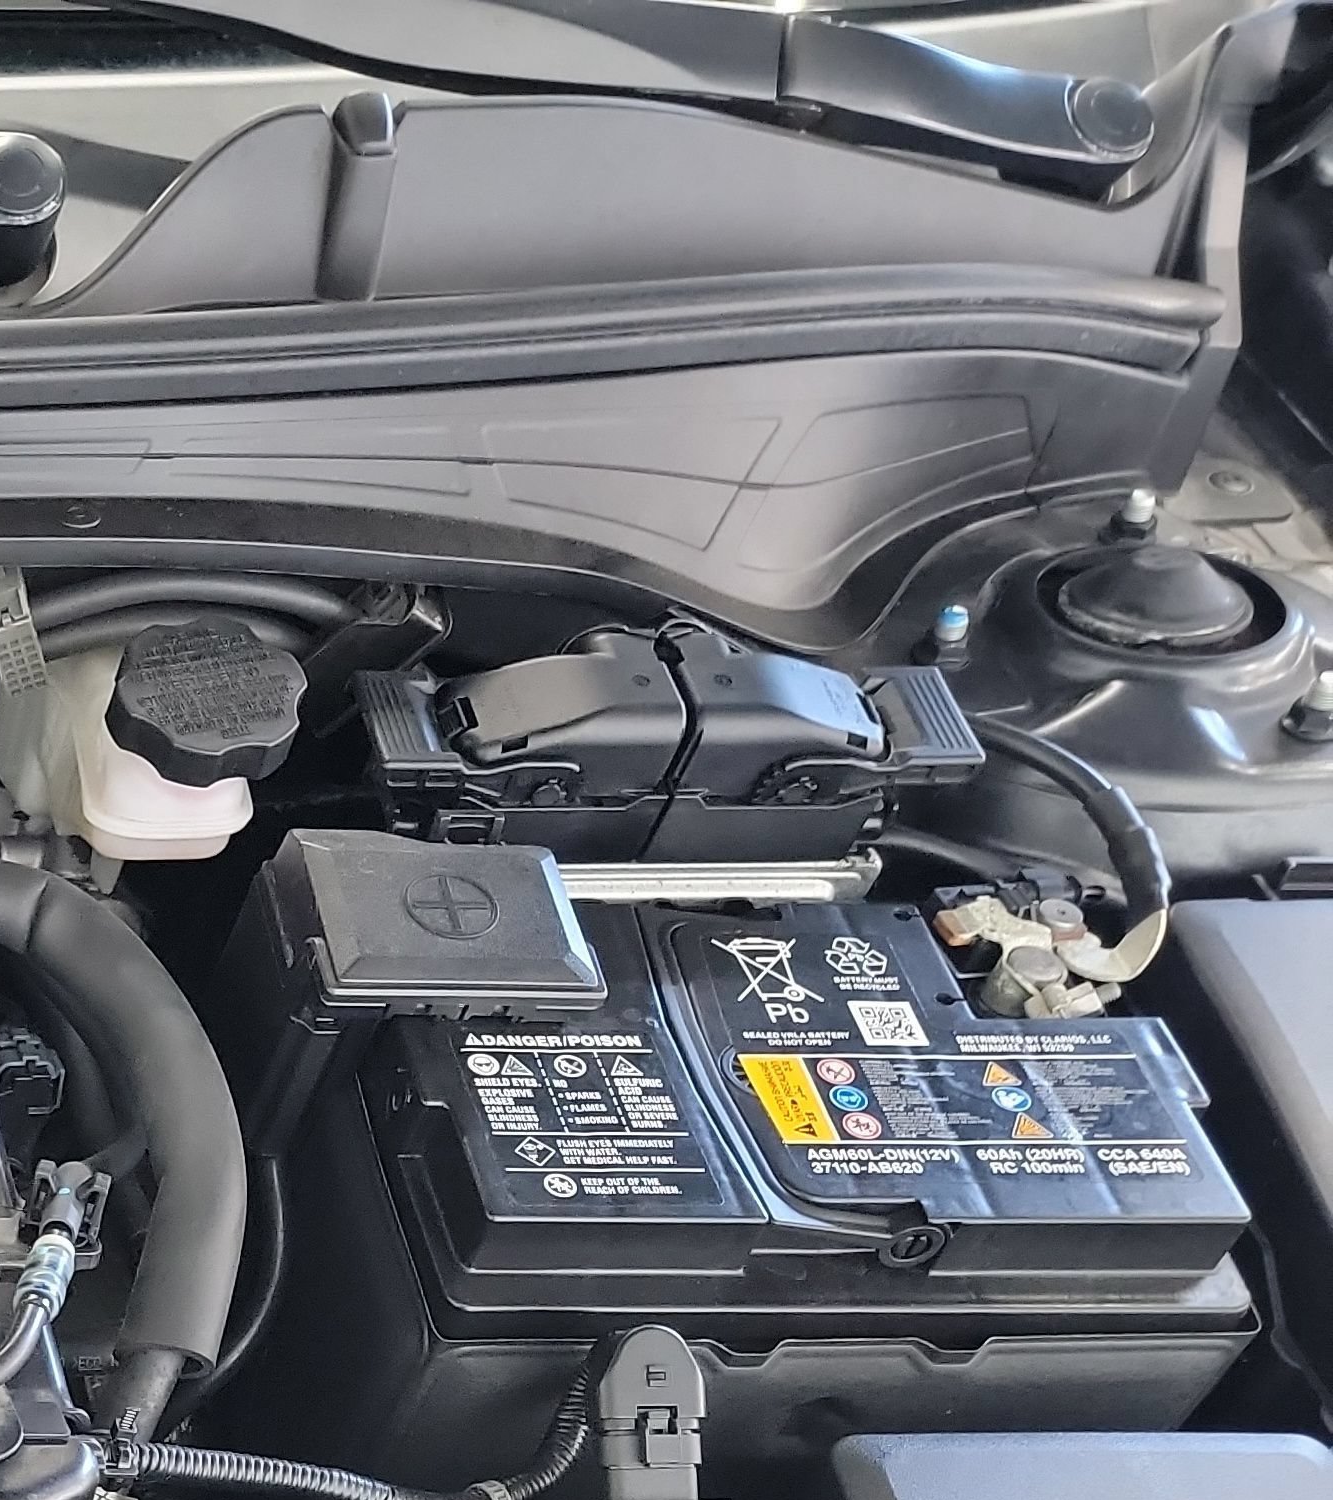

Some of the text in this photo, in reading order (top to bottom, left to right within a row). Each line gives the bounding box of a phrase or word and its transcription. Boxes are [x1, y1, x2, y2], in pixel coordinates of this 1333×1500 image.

[765, 1003, 809, 1023] Pb
[808, 1031, 849, 1039] BATTERY
[481, 1035, 642, 1047] DANGER/POISON
[956, 1035, 1024, 1045] DISTRIBUTED
[1025, 1035, 1039, 1043] BY
[1089, 1035, 1112, 1044] LLC
[474, 1078, 542, 1087] SHIELD EYES.
[552, 1079, 568, 1088] NO
[614, 1078, 663, 1088] SULFURIC
[478, 1089, 534, 1097] EXPLOSIVE
[618, 1087, 642, 1095] ACID
[565, 1092, 601, 1100] SPARKS
[570, 1104, 607, 1112] FLAMES
[487, 1114, 539, 1122] BLINDNESS
[575, 1116, 619, 1124] SMOKING
[628, 1112, 678, 1120] OR SEVERE
[491, 1122, 542, 1130] OR INJURY.
[556, 1140, 674, 1148] FLUSH EYES IMMEDIATELY
[808, 1148, 959, 1163] AGM60L-DIN(12V)
[976, 1149, 1085, 1162] 60Ah (20HR)
[1097, 1149, 1186, 1160] CCA 640A
[811, 1162, 924, 1174] 37110-AB620
[990, 1161, 1085, 1174] RC 100min
[1108, 1161, 1190, 1176] (SAE/EN)
[581, 1178, 605, 1186] KEEP
[606, 1178, 626, 1186] OUT
[584, 1186, 616, 1194] REACH
[632, 1186, 682, 1194] CHILDREN.
